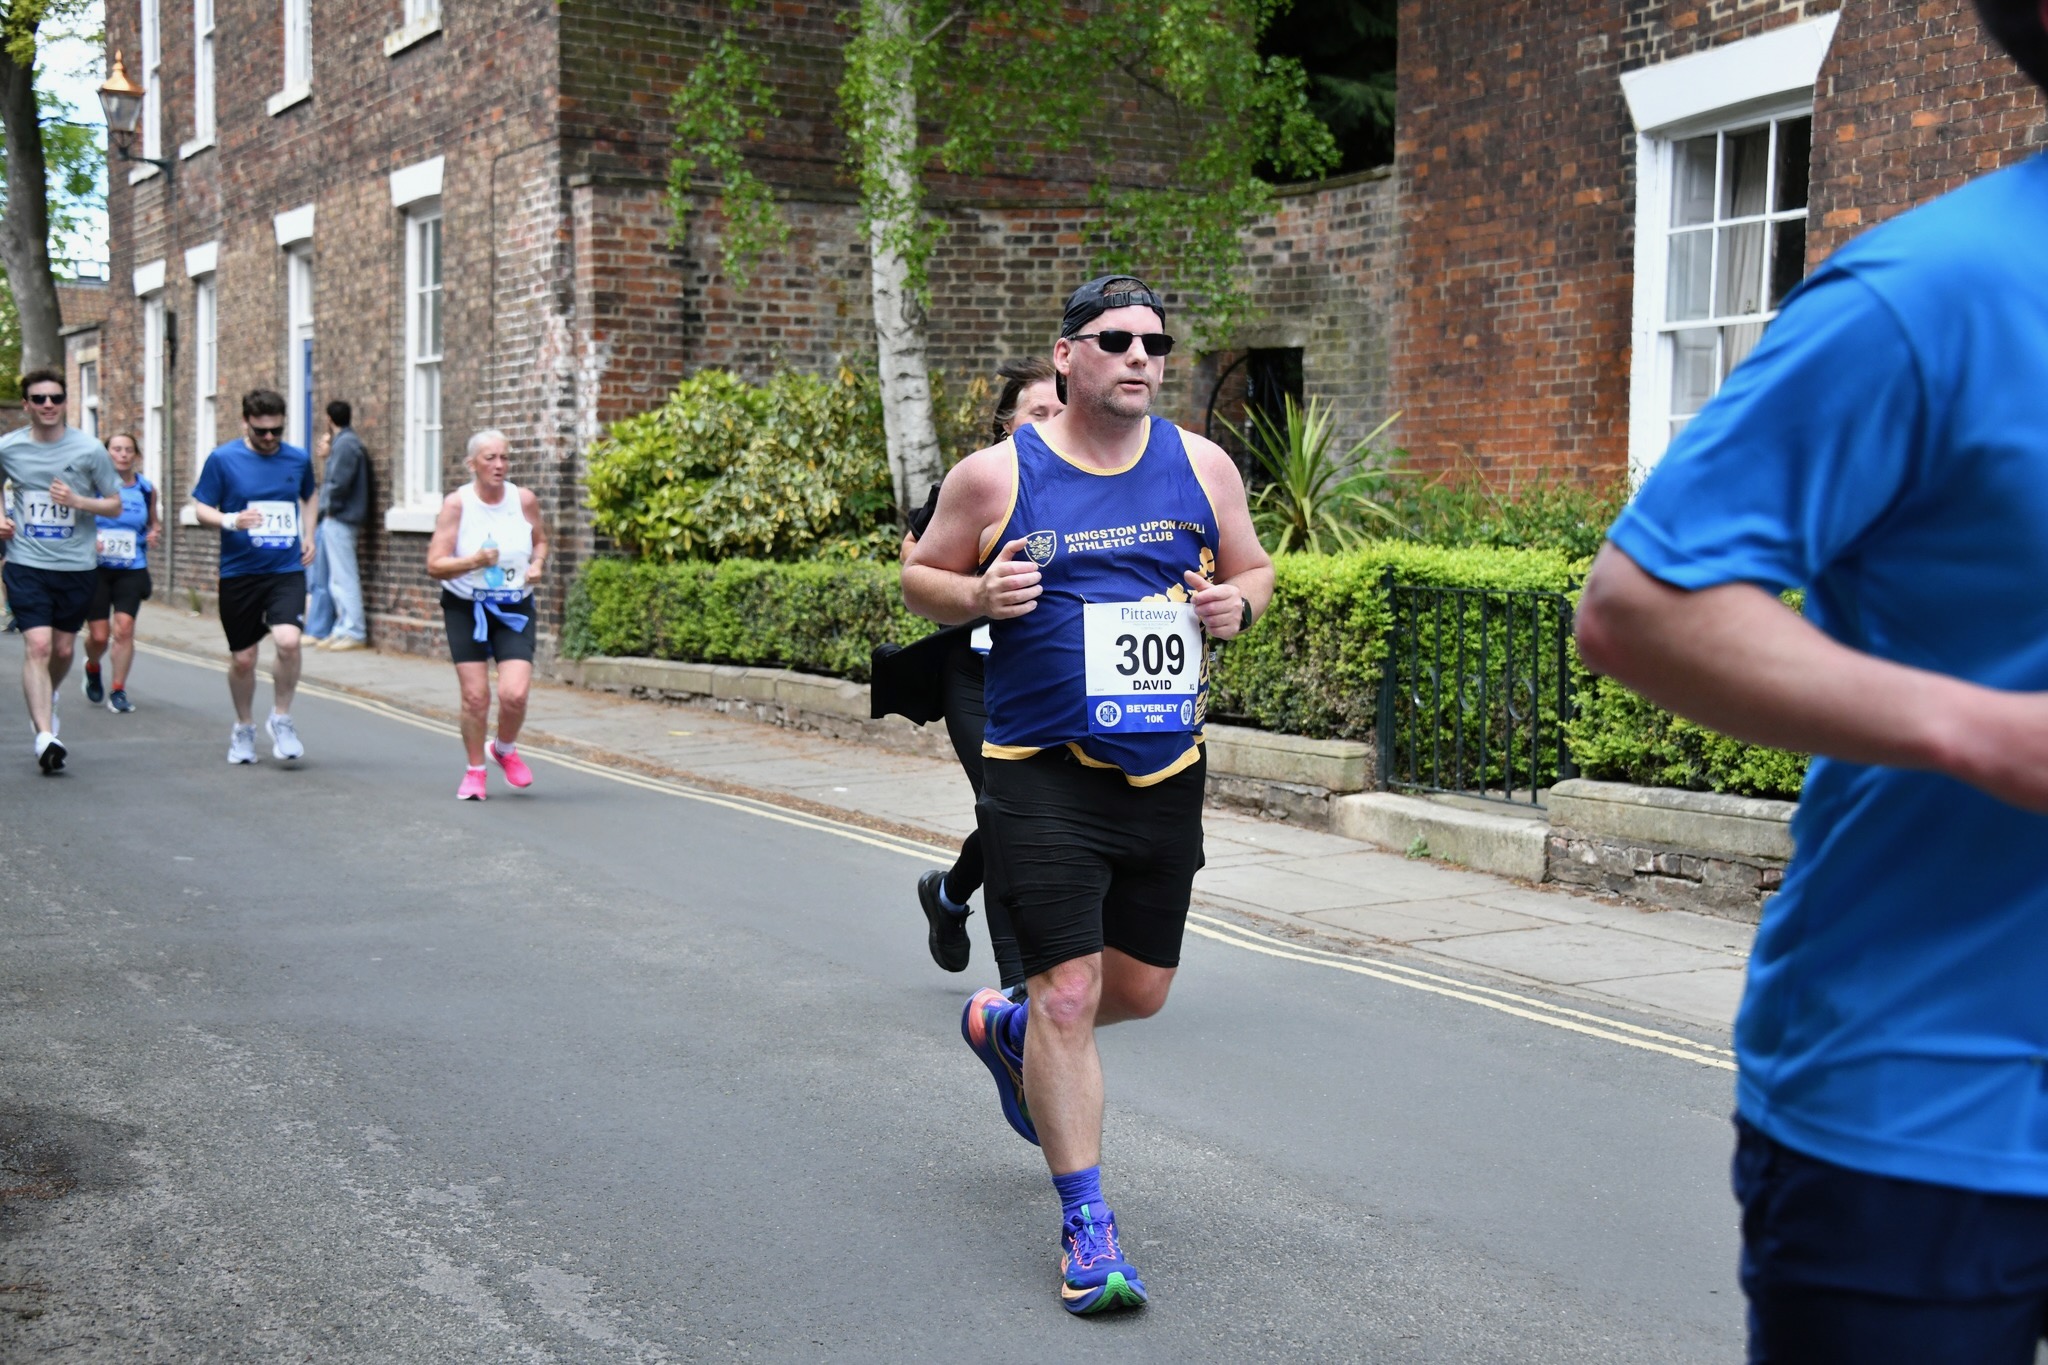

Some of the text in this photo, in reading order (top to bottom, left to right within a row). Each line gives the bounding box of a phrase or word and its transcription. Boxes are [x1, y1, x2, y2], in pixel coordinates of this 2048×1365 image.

[29, 503, 69, 519] 1719
[266, 514, 292, 529] 718
[1064, 525, 1137, 544] KINGSTON
[1140, 520, 1176, 532] UPON
[102, 541, 132, 553] 975
[1068, 531, 1174, 553] ATHLETIC CLUB
[1121, 607, 1178, 623] Pittaway
[1115, 633, 1185, 676] 309
[1133, 680, 1172, 691] DAVID
[1126, 704, 1178, 713] BEVERLEY
[1144, 714, 1164, 723] 10K
